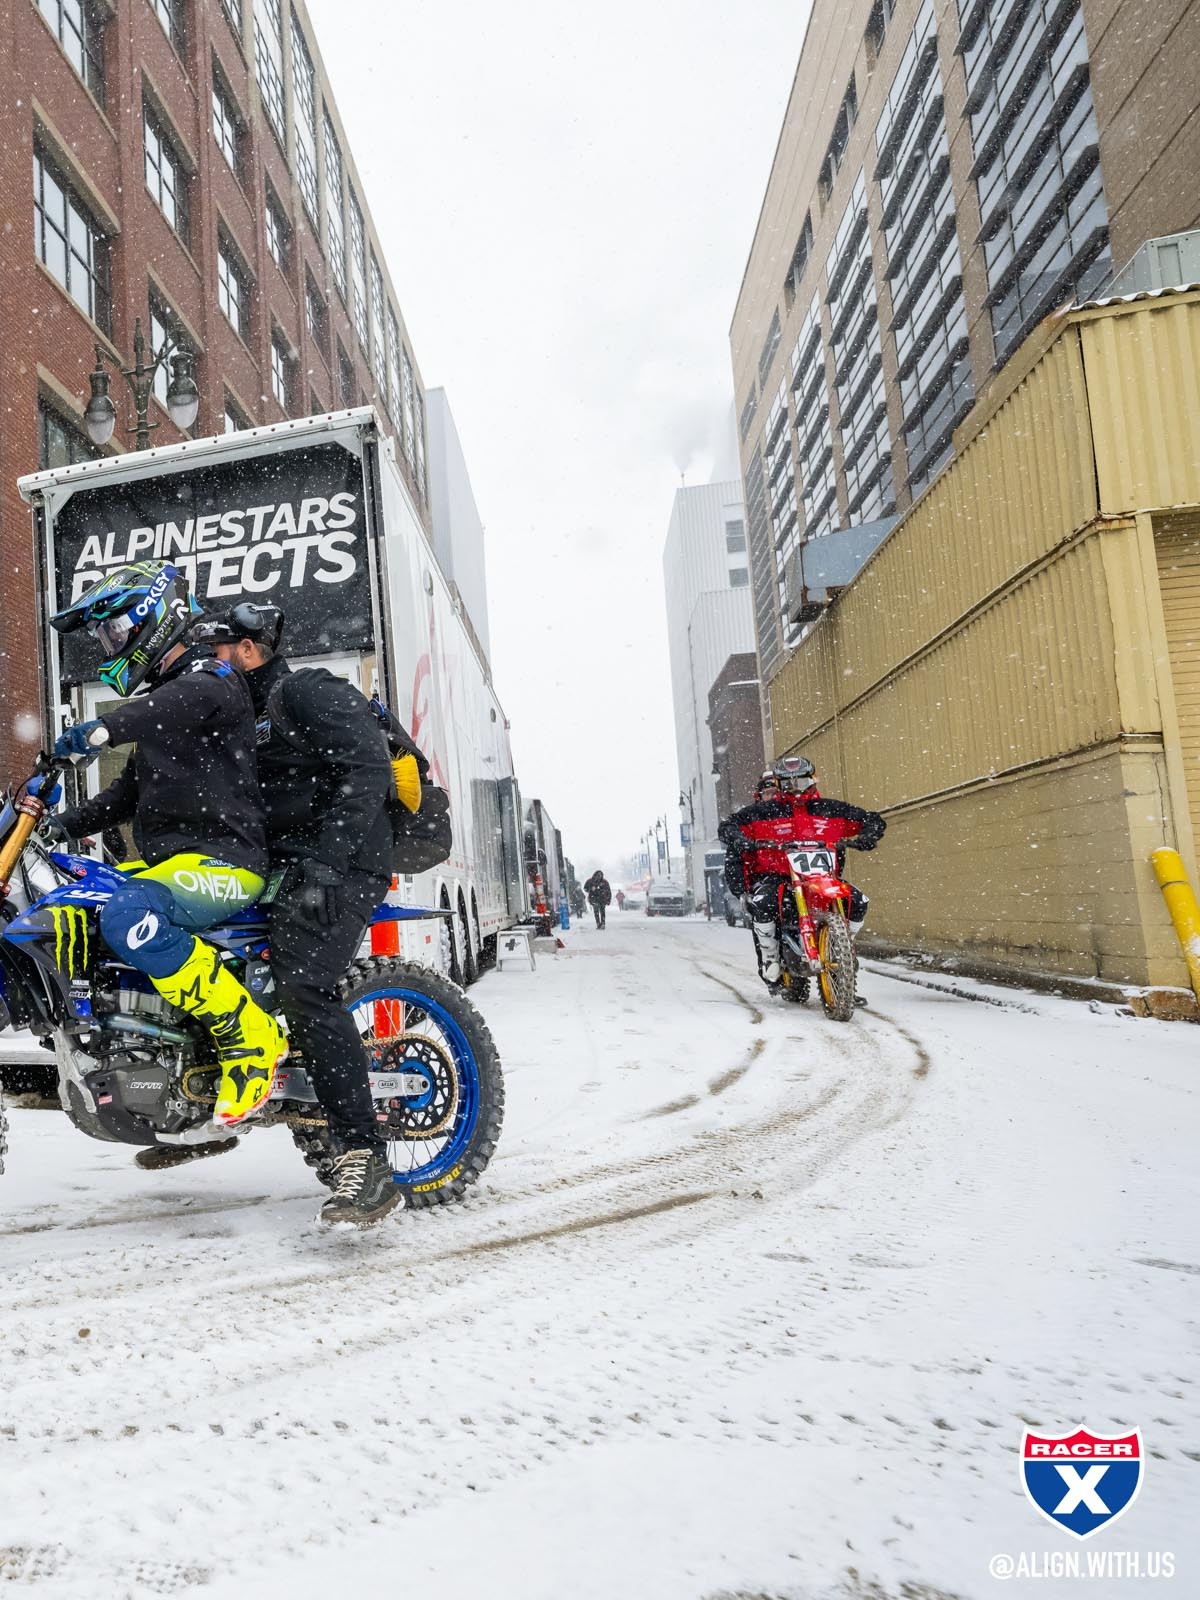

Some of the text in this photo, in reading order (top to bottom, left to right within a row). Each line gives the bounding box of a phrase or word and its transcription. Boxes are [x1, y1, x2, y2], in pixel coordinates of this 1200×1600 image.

[75, 492, 357, 570] ALPINESTARS
[71, 531, 357, 606] PTECTS
[135, 572, 170, 616] OAKLEY
[145, 614, 174, 650] MONSTER
[793, 853, 830, 873] 14
[412, 1168, 461, 1193] DUNLOP
